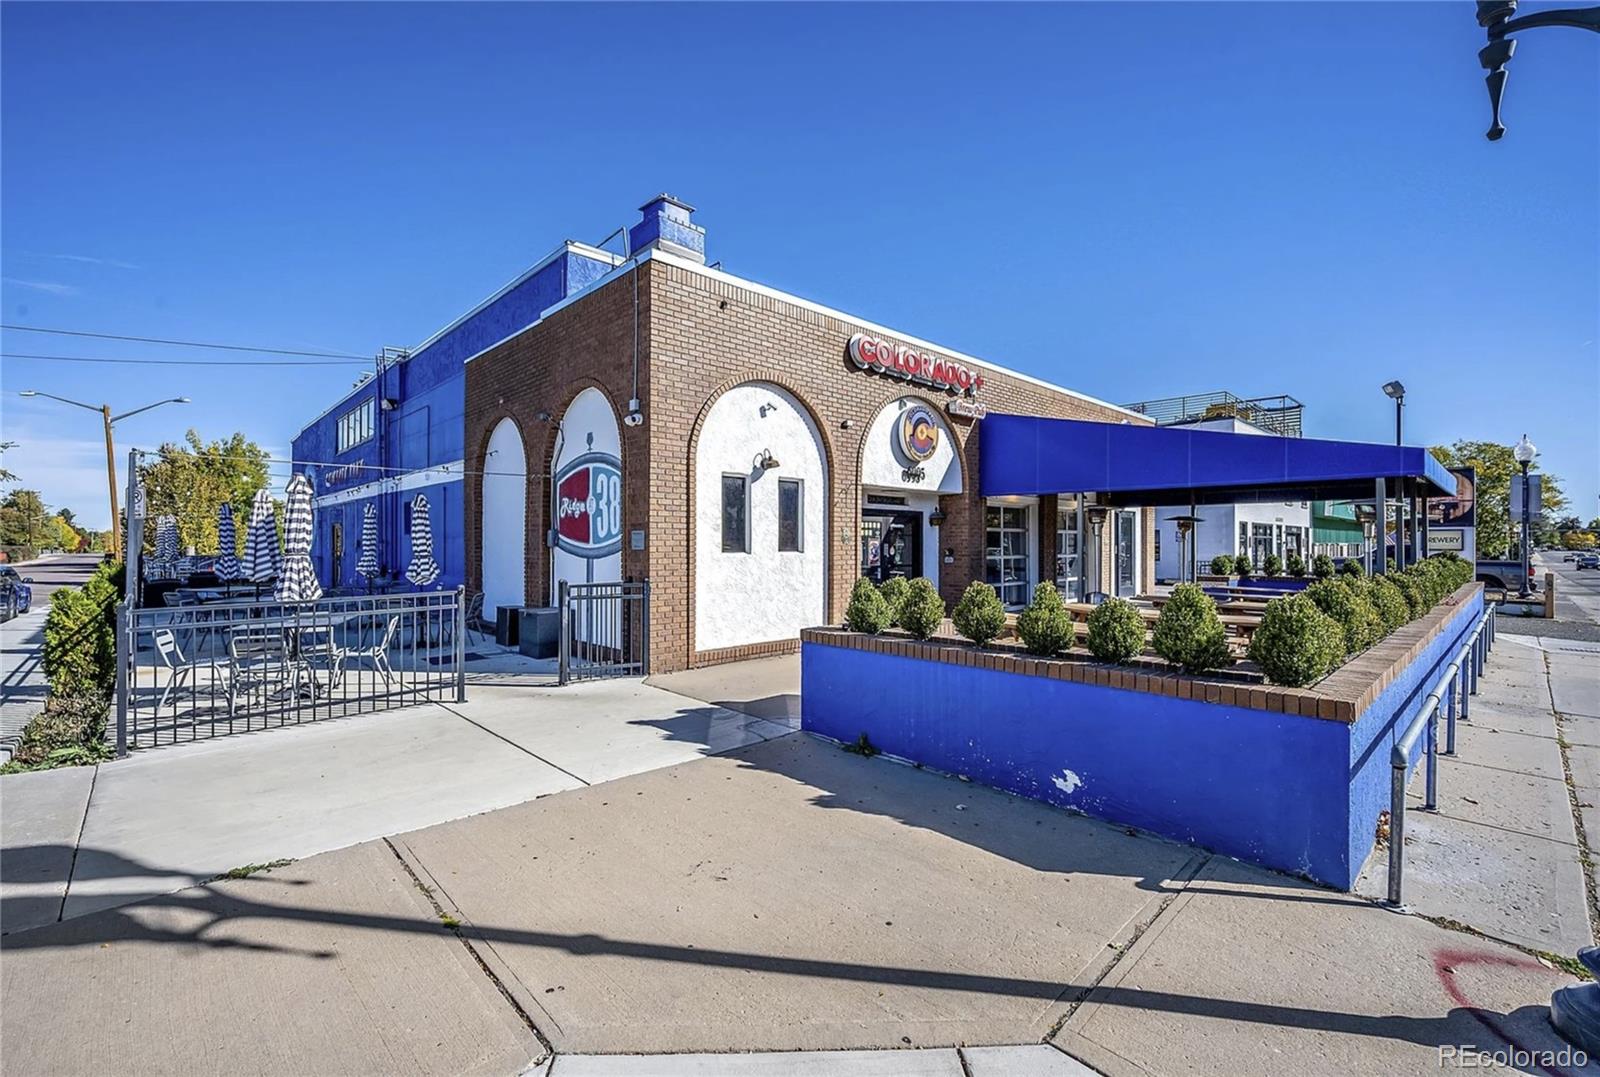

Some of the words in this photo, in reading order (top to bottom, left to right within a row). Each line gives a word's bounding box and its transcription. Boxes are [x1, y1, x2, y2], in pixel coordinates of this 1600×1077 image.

[858, 334, 971, 389] COLORADO
[560, 497, 586, 518] Ridge
[597, 473, 620, 538] 38
[1427, 536, 1460, 544] REWERY
